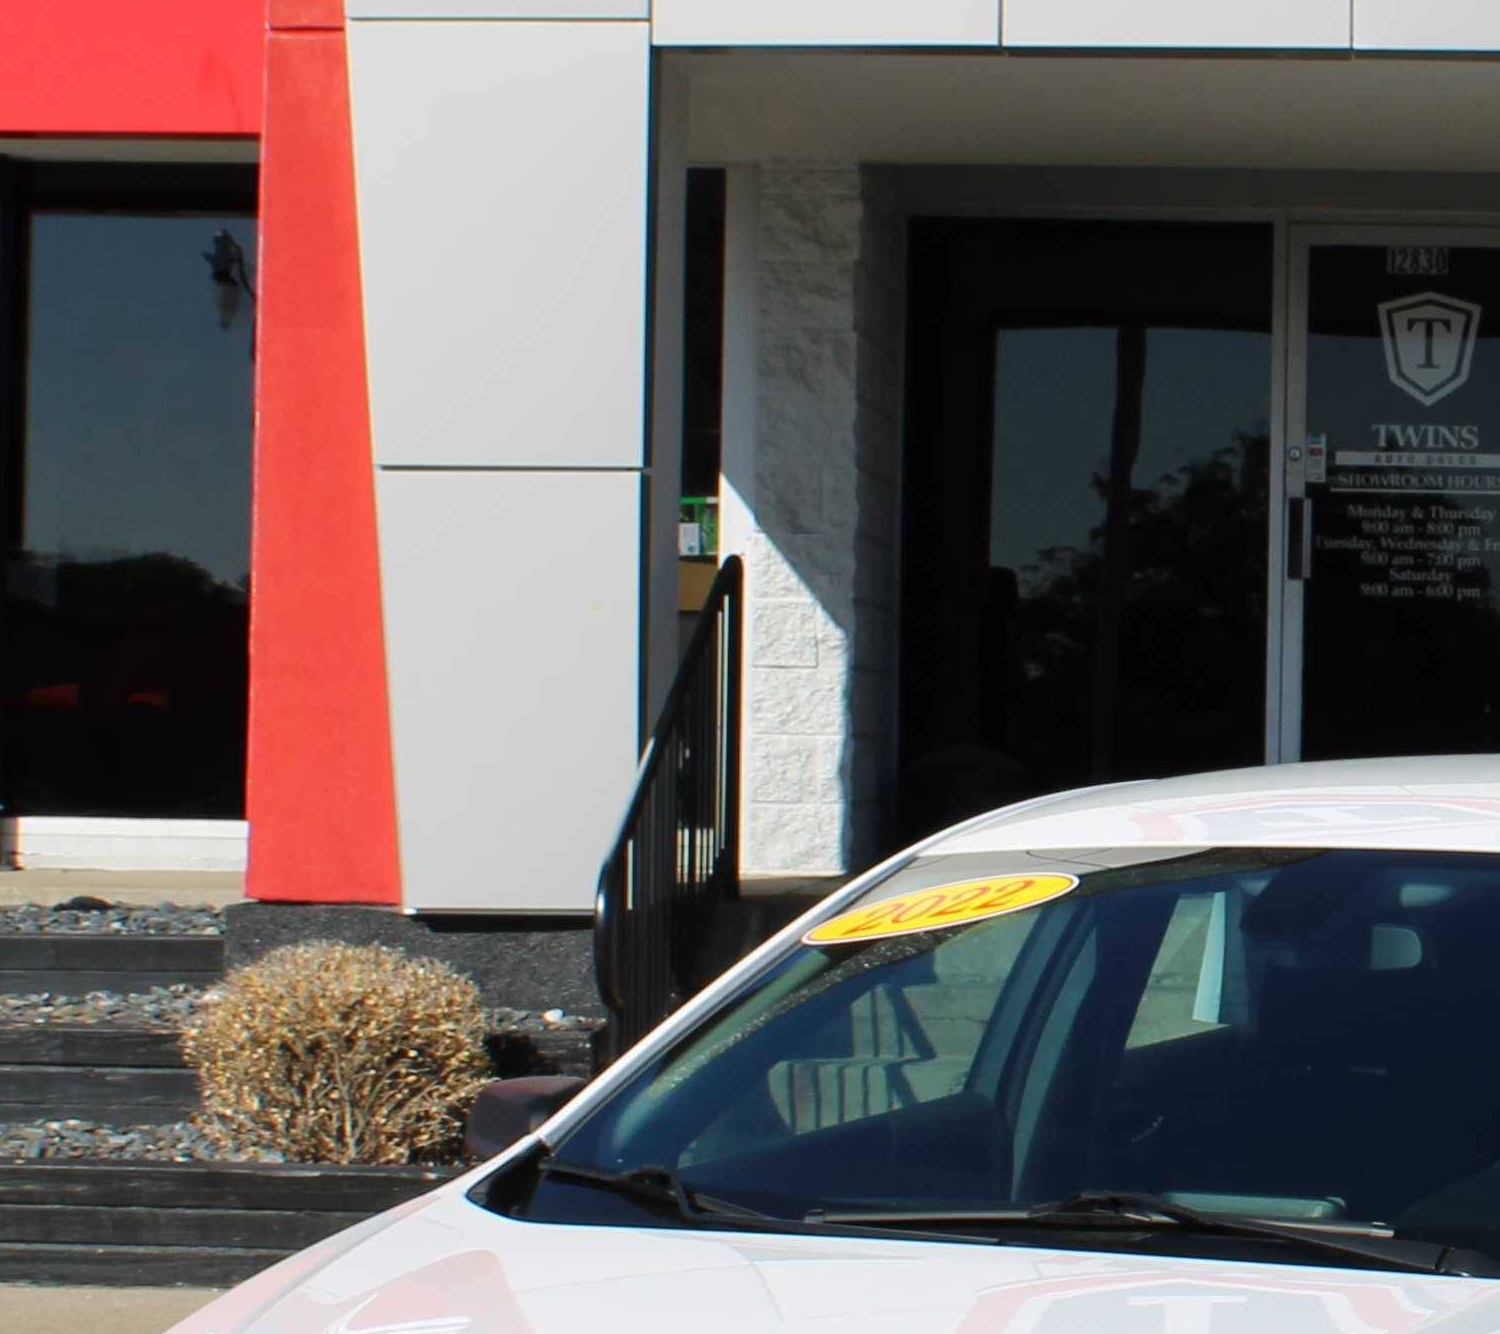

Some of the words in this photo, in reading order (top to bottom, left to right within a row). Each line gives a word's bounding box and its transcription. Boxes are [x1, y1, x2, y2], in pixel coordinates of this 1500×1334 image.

[1407, 317, 1453, 369] T
[1372, 424, 1480, 448] TWINS
[1337, 473, 1443, 488] SHOWROOM
[1347, 504, 1408, 521] Monday
[1412, 506, 1426, 520] &
[1430, 505, 1496, 522] Thursday
[1361, 522, 1389, 534] 9:00
[1392, 525, 1414, 534] am
[1457, 525, 1481, 539] pm
[1380, 536, 1463, 552] Wednesday
[1467, 539, 1480, 551] &
[1392, 555, 1414, 565] am
[1457, 555, 1481, 569] pm
[1389, 567, 1453, 583] Saturday
[1391, 586, 1414, 597] am
[1456, 586, 1481, 601] pm
[840, 878, 1036, 936] 2022
